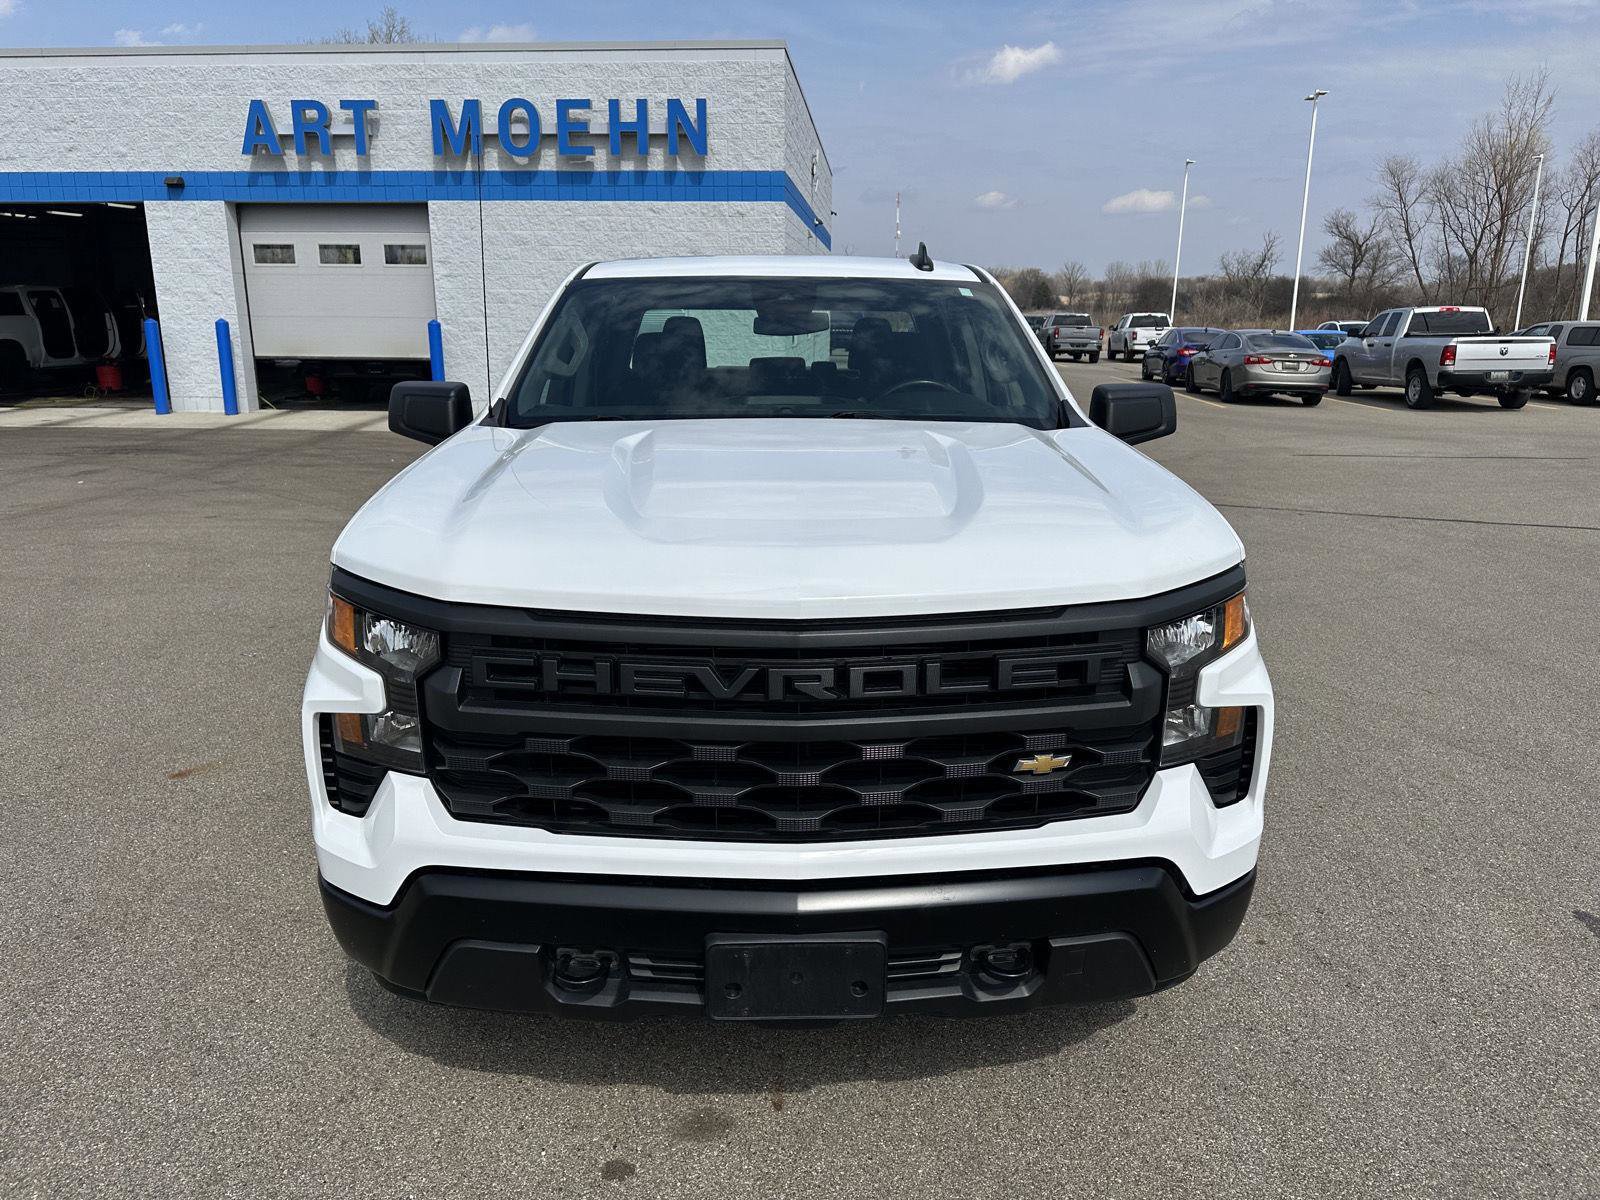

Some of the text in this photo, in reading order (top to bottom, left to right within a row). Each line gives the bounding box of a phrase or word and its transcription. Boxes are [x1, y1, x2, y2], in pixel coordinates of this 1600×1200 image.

[242, 97, 708, 157] ART MOEHN
[472, 650, 1122, 701] CHEVROLET
